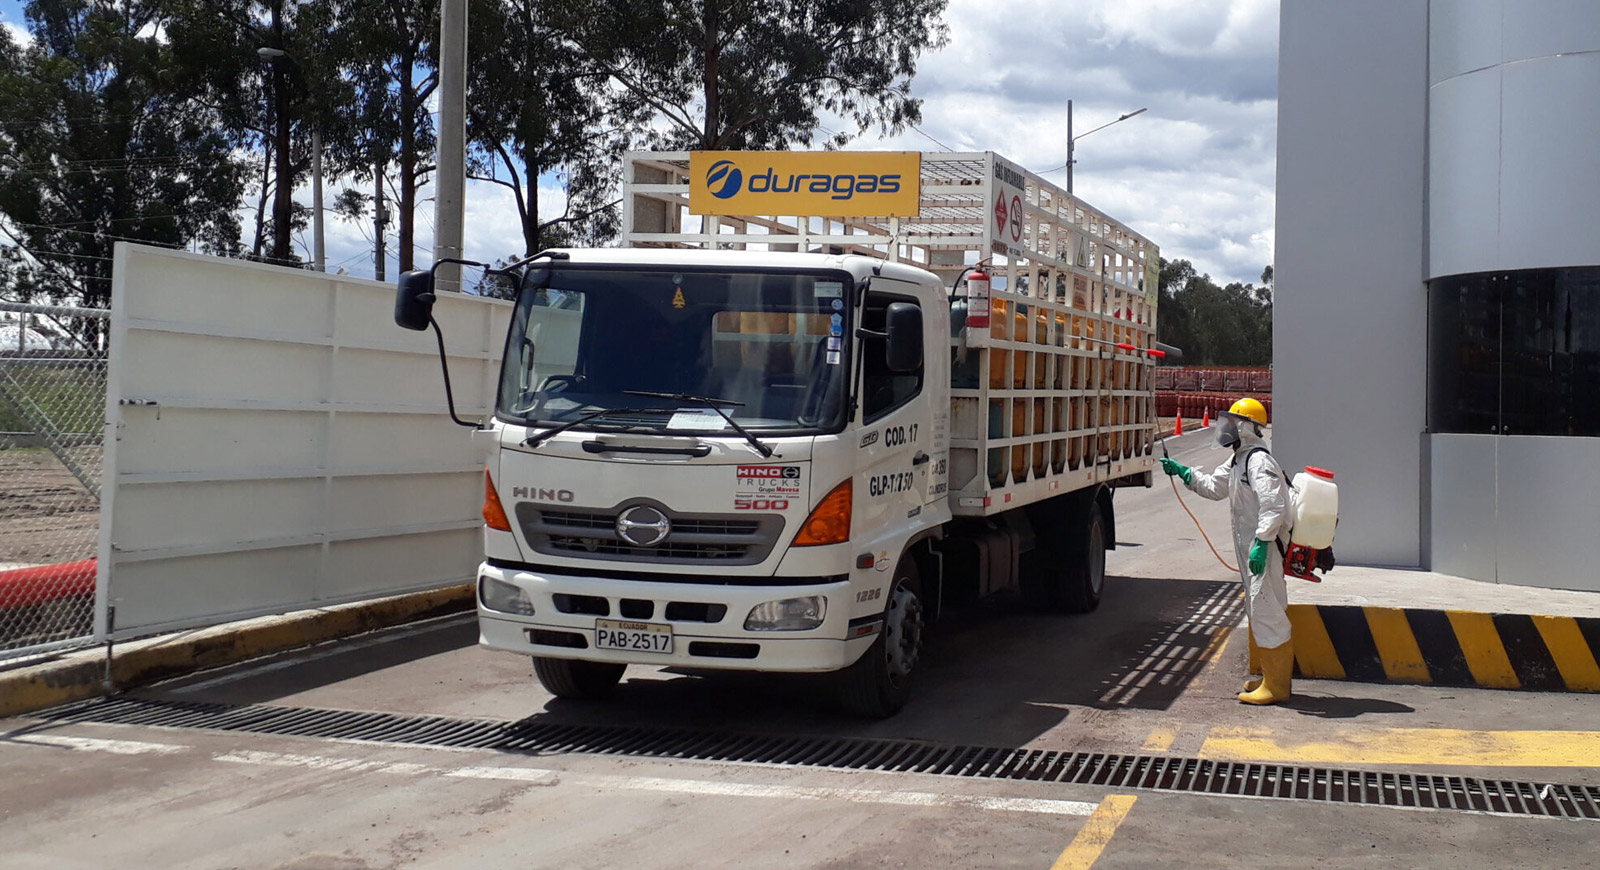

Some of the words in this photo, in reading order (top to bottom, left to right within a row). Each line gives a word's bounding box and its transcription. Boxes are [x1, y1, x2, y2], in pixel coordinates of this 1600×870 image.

[748, 167, 902, 200] duragas
[885, 426, 906, 447] COD.
[909, 423, 918, 442] 17
[737, 468, 781, 476] HINO
[737, 479, 800, 487] TRUCKS
[513, 486, 574, 502] HINO
[734, 499, 789, 510] 500
[856, 588, 881, 603] 1226
[619, 622, 648, 631] ECUADOR
[598, 630, 669, 651] PAB-2517
